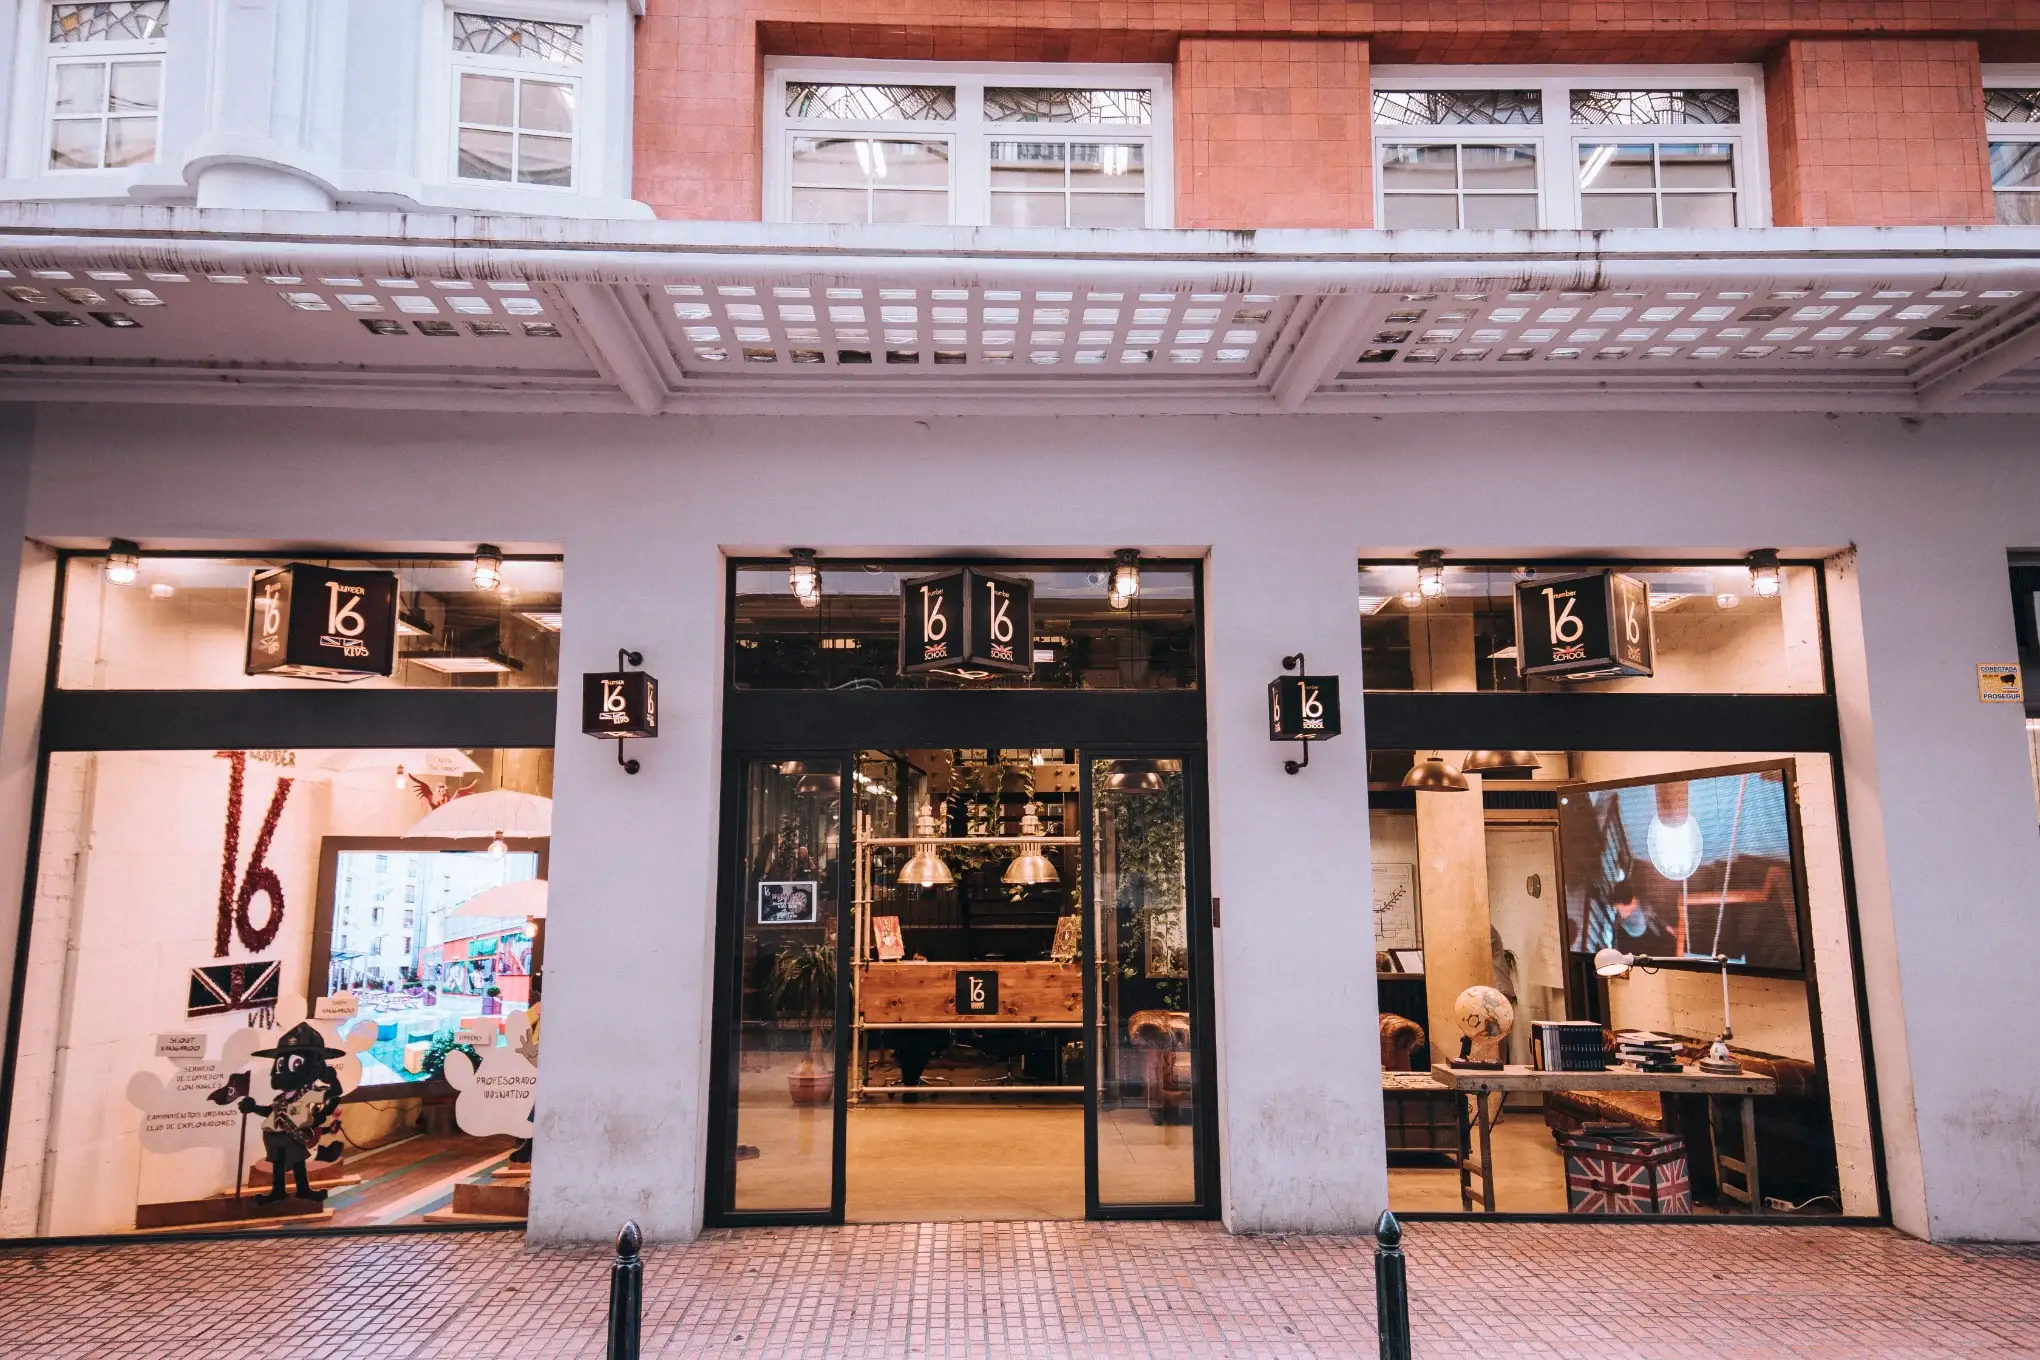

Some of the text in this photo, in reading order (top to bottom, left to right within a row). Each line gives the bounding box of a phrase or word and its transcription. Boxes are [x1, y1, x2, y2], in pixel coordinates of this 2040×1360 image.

[927, 588, 945, 597] number
[1553, 589, 1577, 599] number
[262, 583, 281, 637] 16
[325, 581, 366, 637] 16
[919, 585, 947, 643] 16
[986, 581, 1013, 643] 16
[1541, 587, 1584, 644] 16
[1620, 583, 1640, 644] 16
[343, 646, 370, 658] KIDS
[924, 649, 948, 661] SCHOOL
[990, 651, 1014, 662] SCHOOL
[1552, 651, 1587, 662] SCHOOL
[600, 679, 626, 713] 16
[1297, 681, 1324, 719] 16
[212, 750, 296, 958] 16
[968, 976, 985, 1002] 16
[182, 1065, 216, 1073] SERVICIO
[187, 1073, 224, 1082] COMEDOR
[476, 1075, 537, 1086] PROFESORADO
[146, 1109, 238, 1121] CAMPAMENTOS URBANOS
[146, 1124, 165, 1132] CLUB
[176, 1119, 236, 1130] EXPLORADORES
